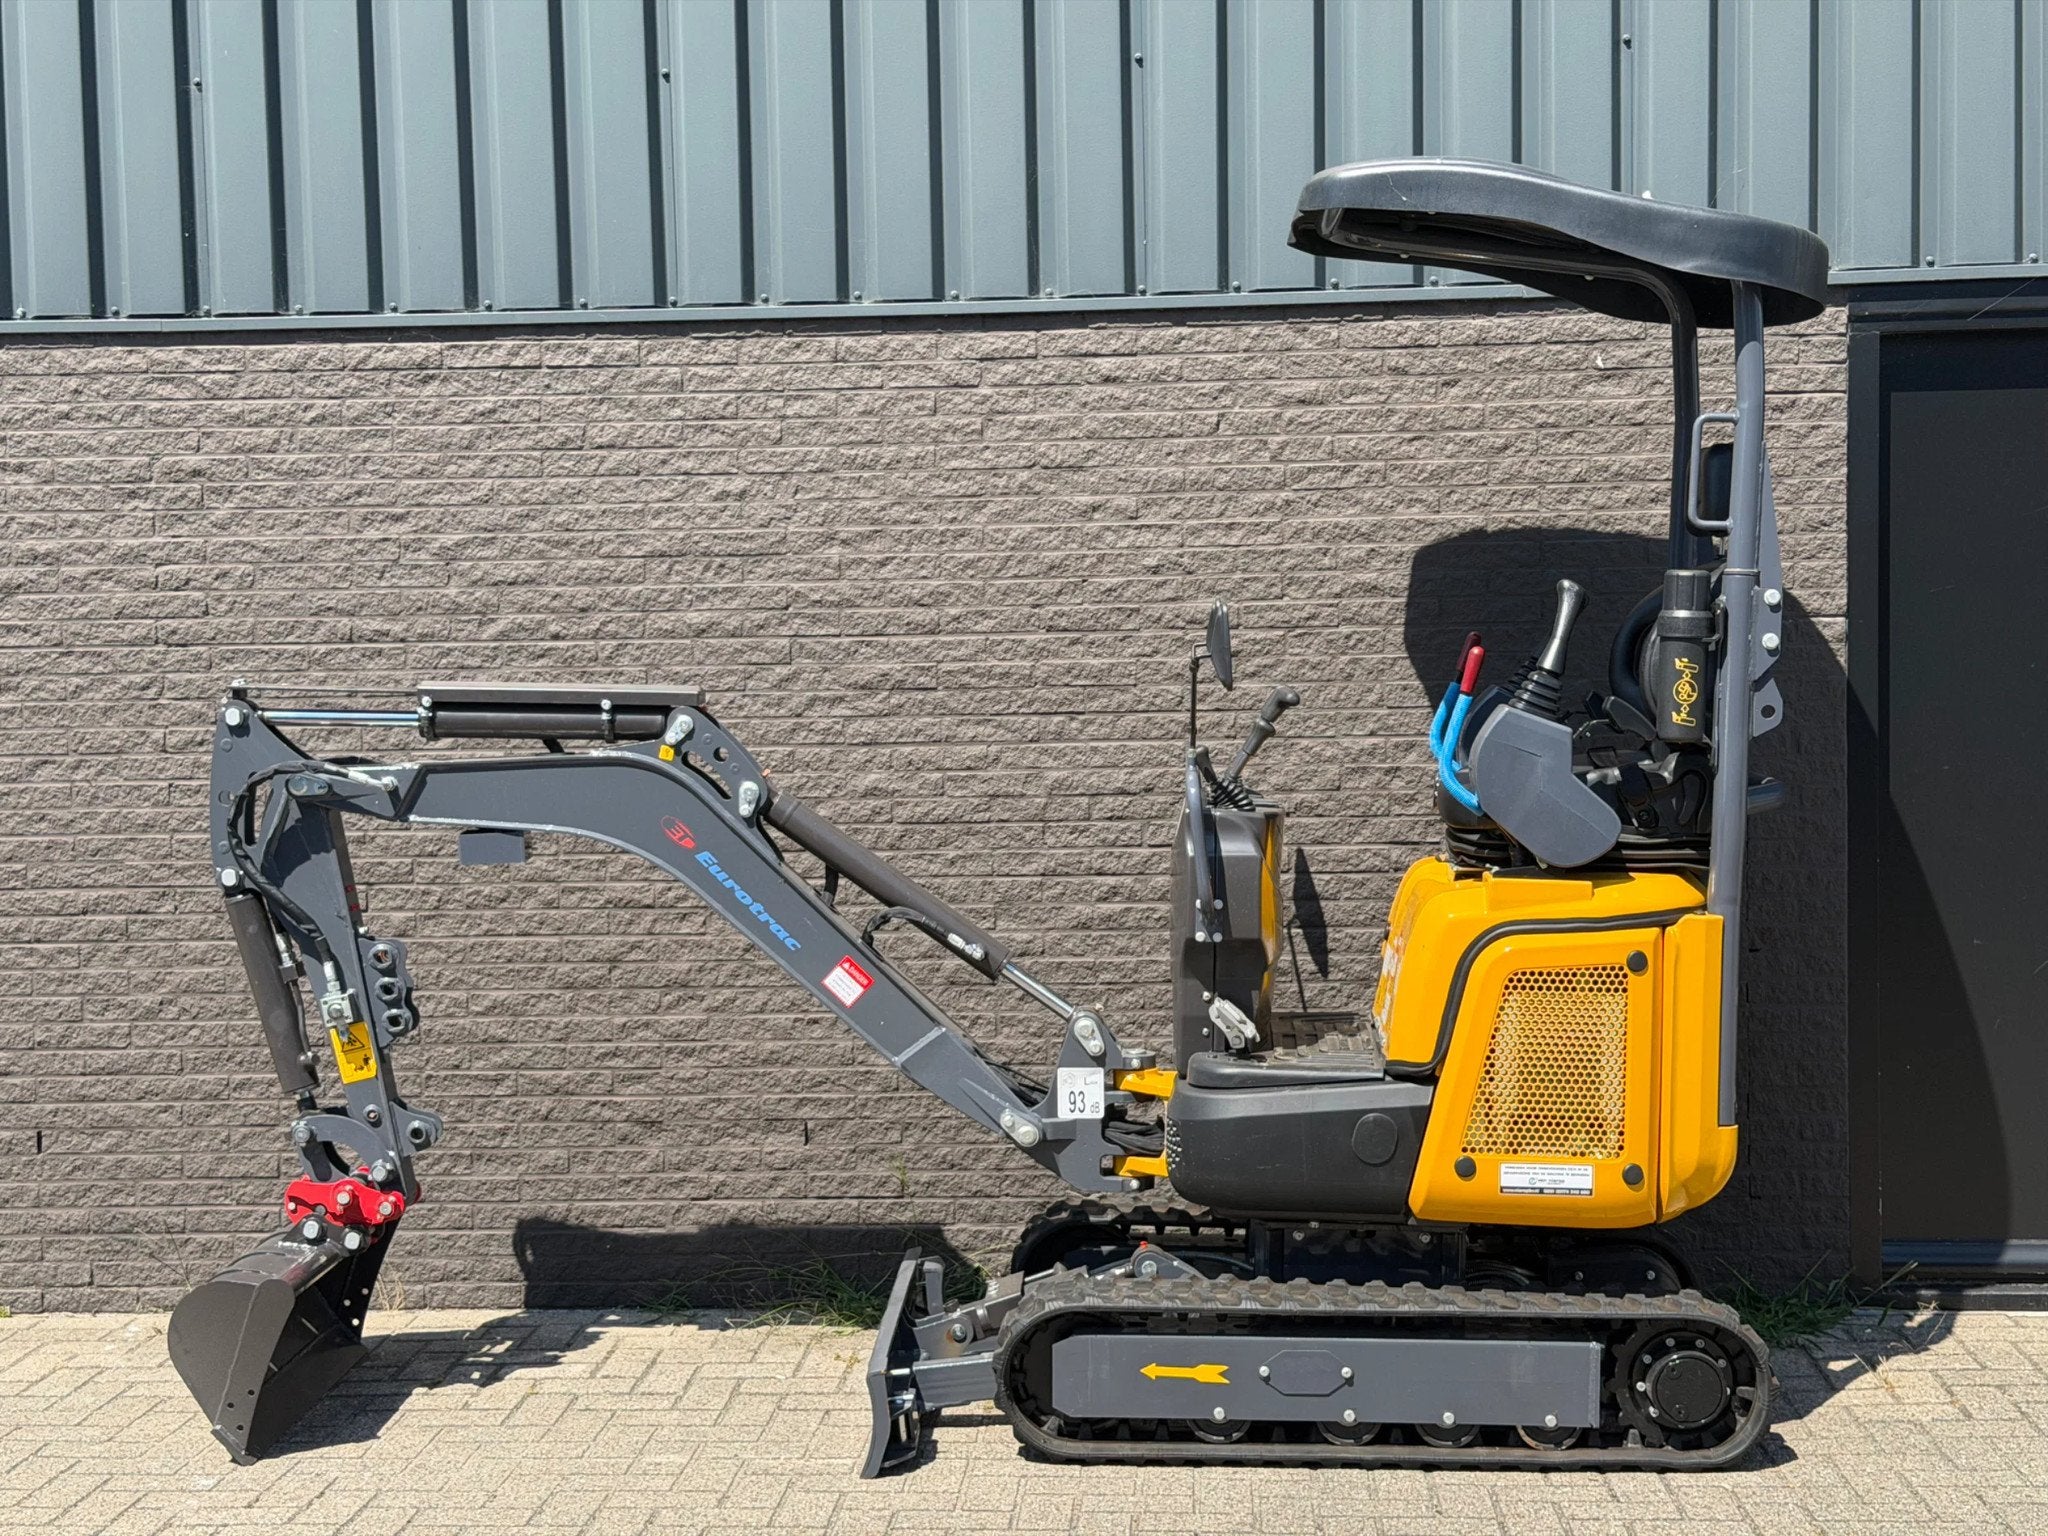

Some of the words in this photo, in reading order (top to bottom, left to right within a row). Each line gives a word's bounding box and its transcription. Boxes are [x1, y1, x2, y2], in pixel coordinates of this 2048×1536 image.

[695, 851, 801, 950] Eurotrac
[1068, 1090, 1086, 1113] 93
[1090, 1101, 1101, 1113] dB
